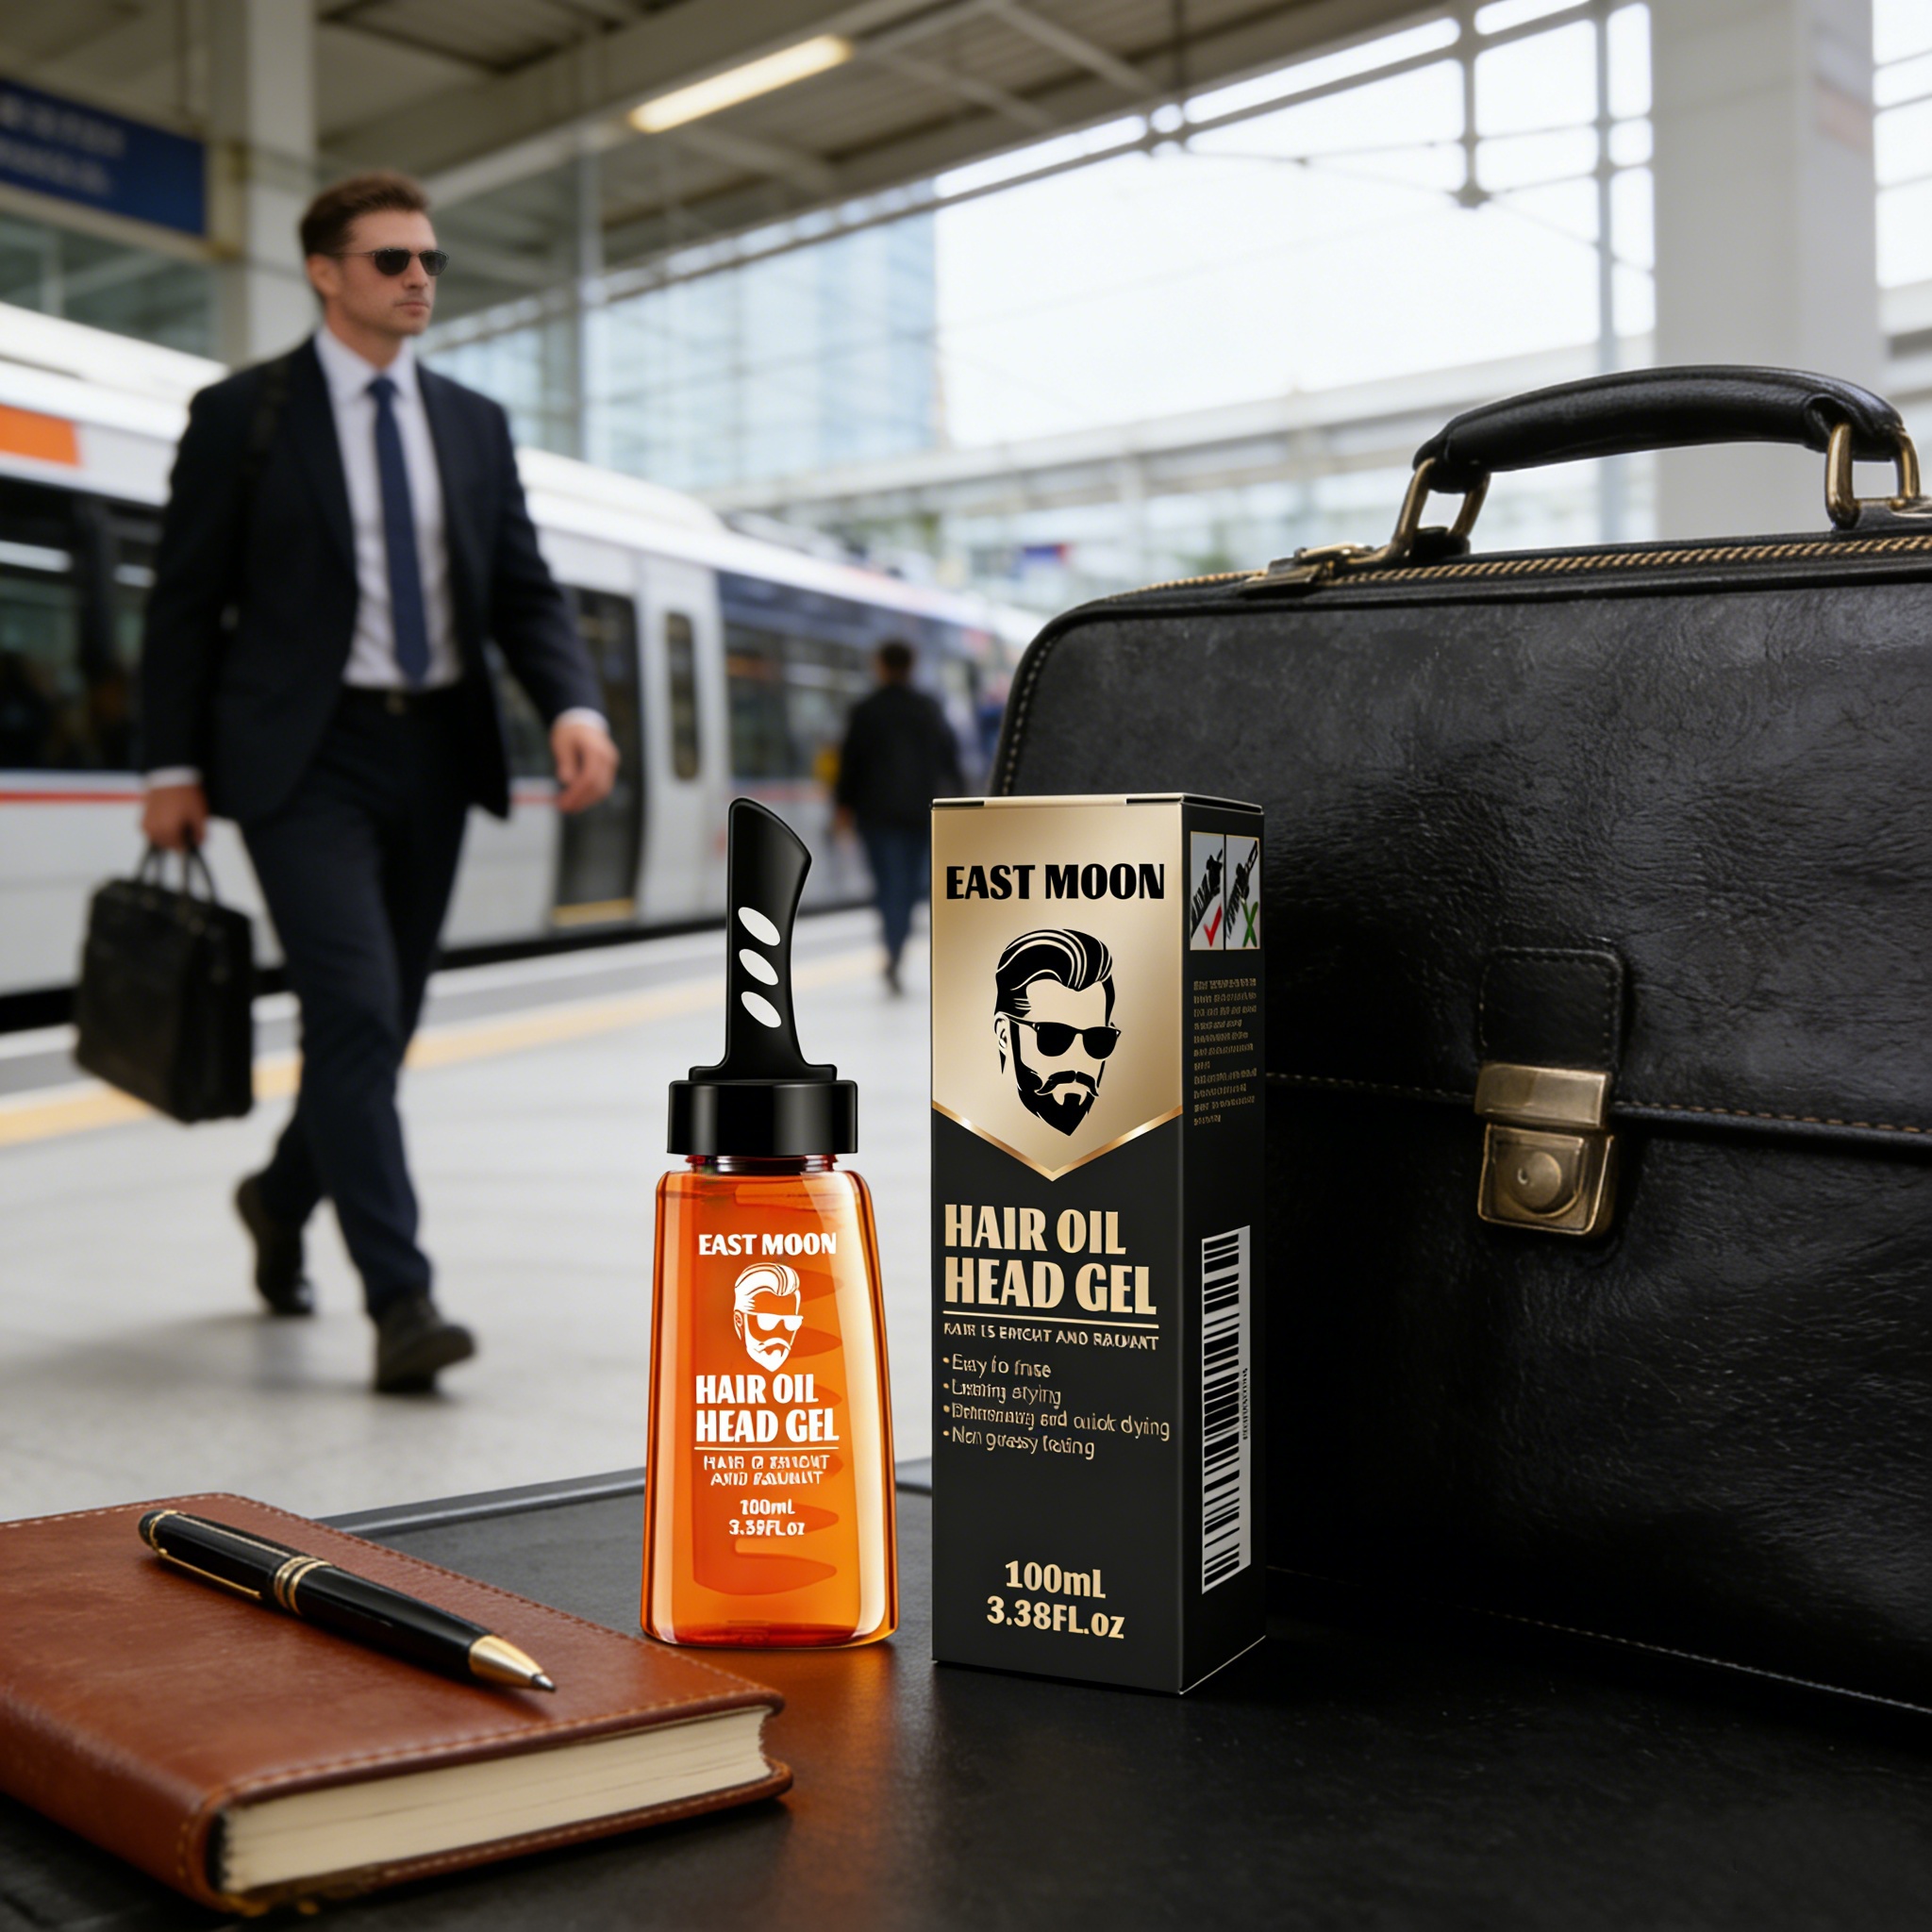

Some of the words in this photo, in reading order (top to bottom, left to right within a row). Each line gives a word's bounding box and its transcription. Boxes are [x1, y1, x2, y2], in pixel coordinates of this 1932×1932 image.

[946, 864, 1036, 900] EAST
[1045, 863, 1165, 900] MOON
[698, 1233, 758, 1256] EAST
[761, 1232, 837, 1255] MOON
[944, 1204, 1048, 1252] HAIR
[1057, 1208, 1126, 1255] OIL
[944, 1257, 1065, 1308] HEAD
[1074, 1262, 1158, 1315] GEL
[695, 1374, 767, 1405] HAIR
[772, 1374, 819, 1404] OIL
[695, 1409, 779, 1443] HEAD
[786, 1407, 840, 1442] GEL
[740, 1498, 796, 1515] 100mL
[1005, 1559, 1107, 1599] 100mL
